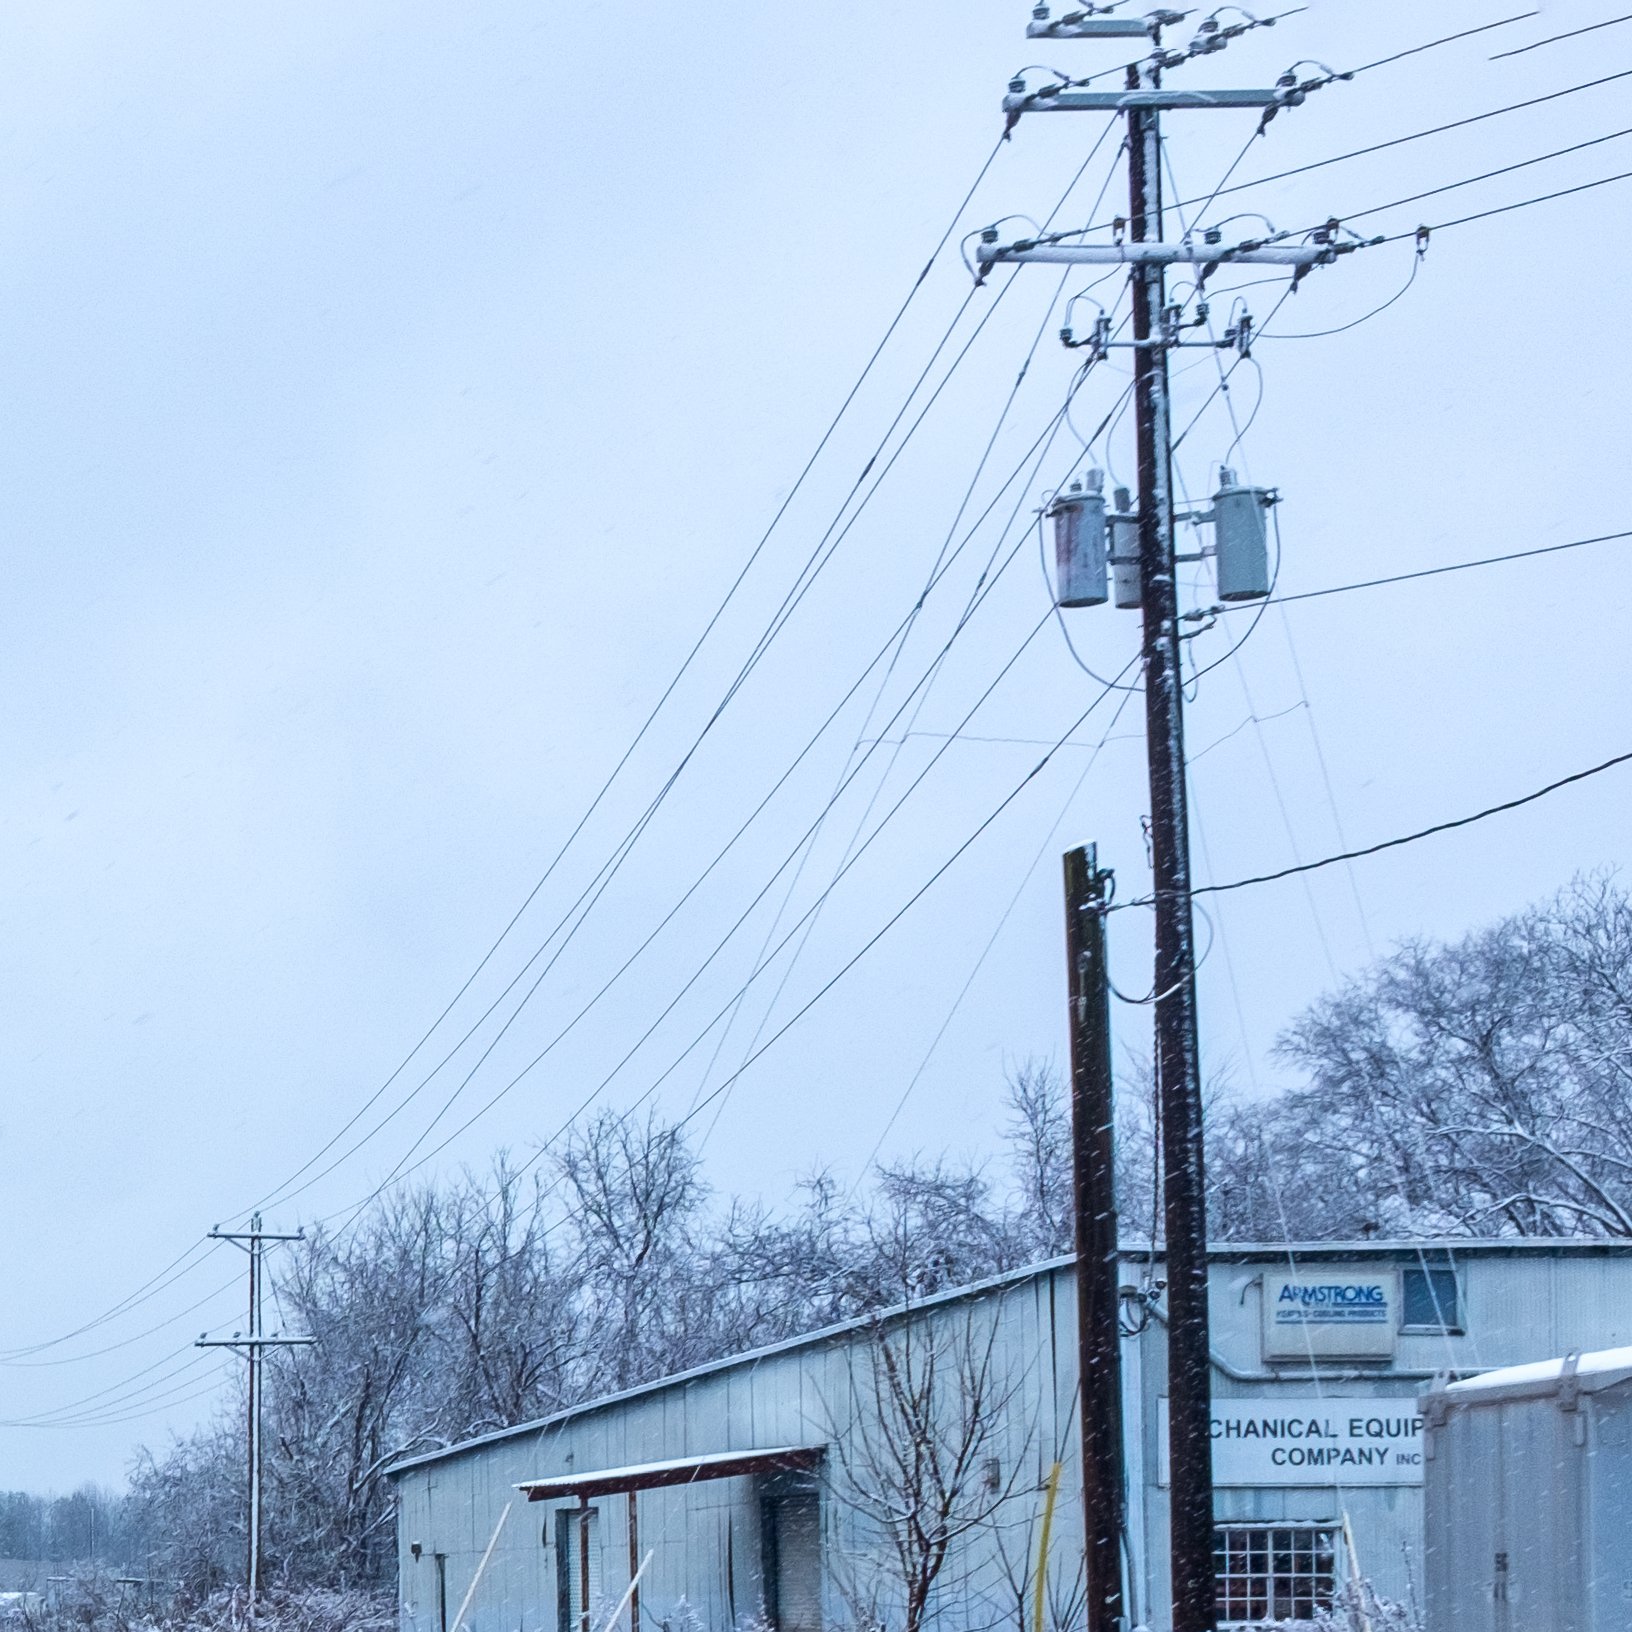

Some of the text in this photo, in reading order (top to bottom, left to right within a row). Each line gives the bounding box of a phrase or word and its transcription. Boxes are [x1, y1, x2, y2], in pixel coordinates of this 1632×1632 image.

[1278, 1284, 1384, 1306] ARMSTRONG
[1270, 1447, 1422, 1466] COMPANY INC
